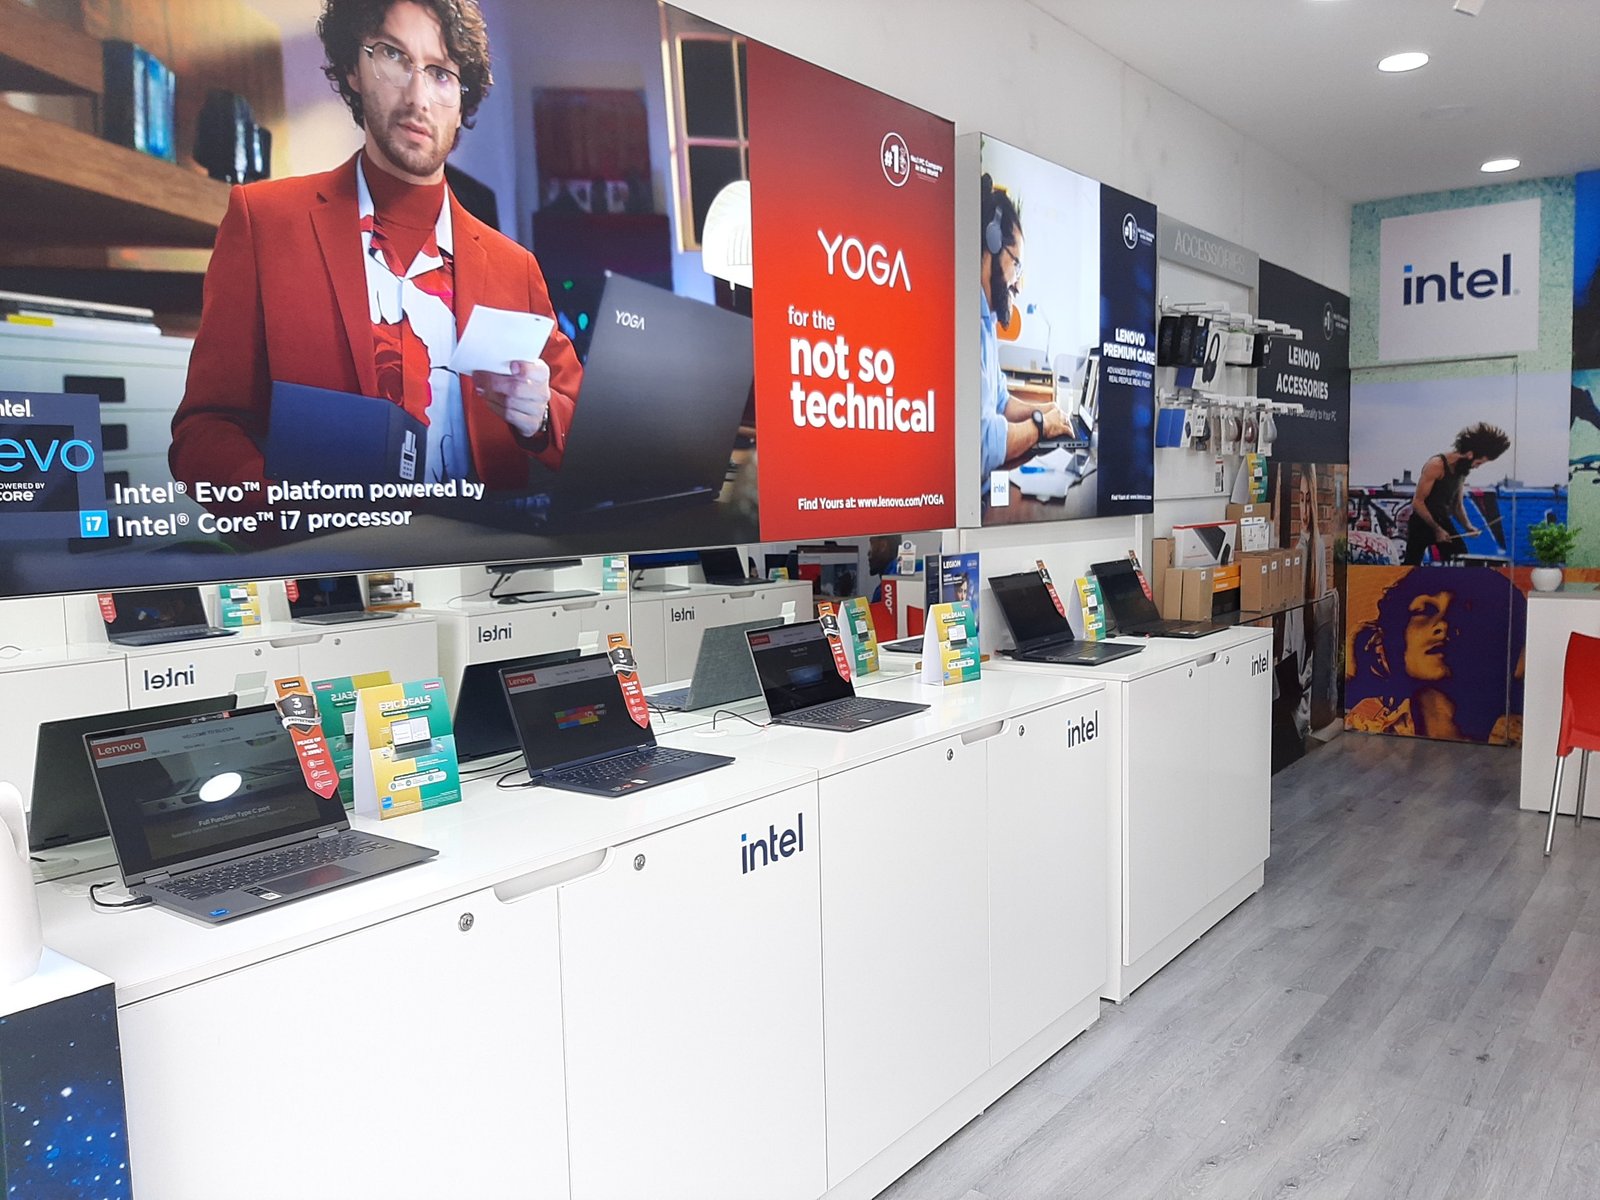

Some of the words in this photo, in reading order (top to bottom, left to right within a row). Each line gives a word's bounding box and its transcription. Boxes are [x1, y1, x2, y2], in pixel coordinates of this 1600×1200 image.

[817, 229, 911, 292] YOGA
[616, 310, 645, 330] YOGA
[788, 306, 809, 327] for
[813, 310, 835, 331] the
[1115, 328, 1146, 347] LENOVO
[790, 336, 849, 380] not
[858, 347, 895, 384] so
[1103, 343, 1136, 361] PREMIUM
[1137, 349, 1156, 366] CARE
[1288, 345, 1320, 371] LENOVO
[1276, 373, 1328, 400] ACCESSORIES
[790, 382, 935, 432] technical
[0, 438, 95, 472] evo
[267, 480, 364, 504] platform
[370, 479, 457, 502] powered
[462, 479, 485, 500] by
[798, 498, 818, 510] Find
[819, 497, 844, 509] Yours
[858, 494, 944, 508] www.lenovo.com/YOGA
[86, 516, 102, 531] i7
[280, 511, 301, 530] i7
[308, 510, 413, 532] processor
[1252, 650, 1268, 676] intel
[508, 676, 534, 686] Lenovo
[291, 698, 302, 709] 3
[380, 701, 401, 711] EPIC
[401, 695, 432, 706] DEALS
[1068, 710, 1098, 748] intel
[98, 741, 142, 757] Lenovo
[742, 812, 804, 875] intel
